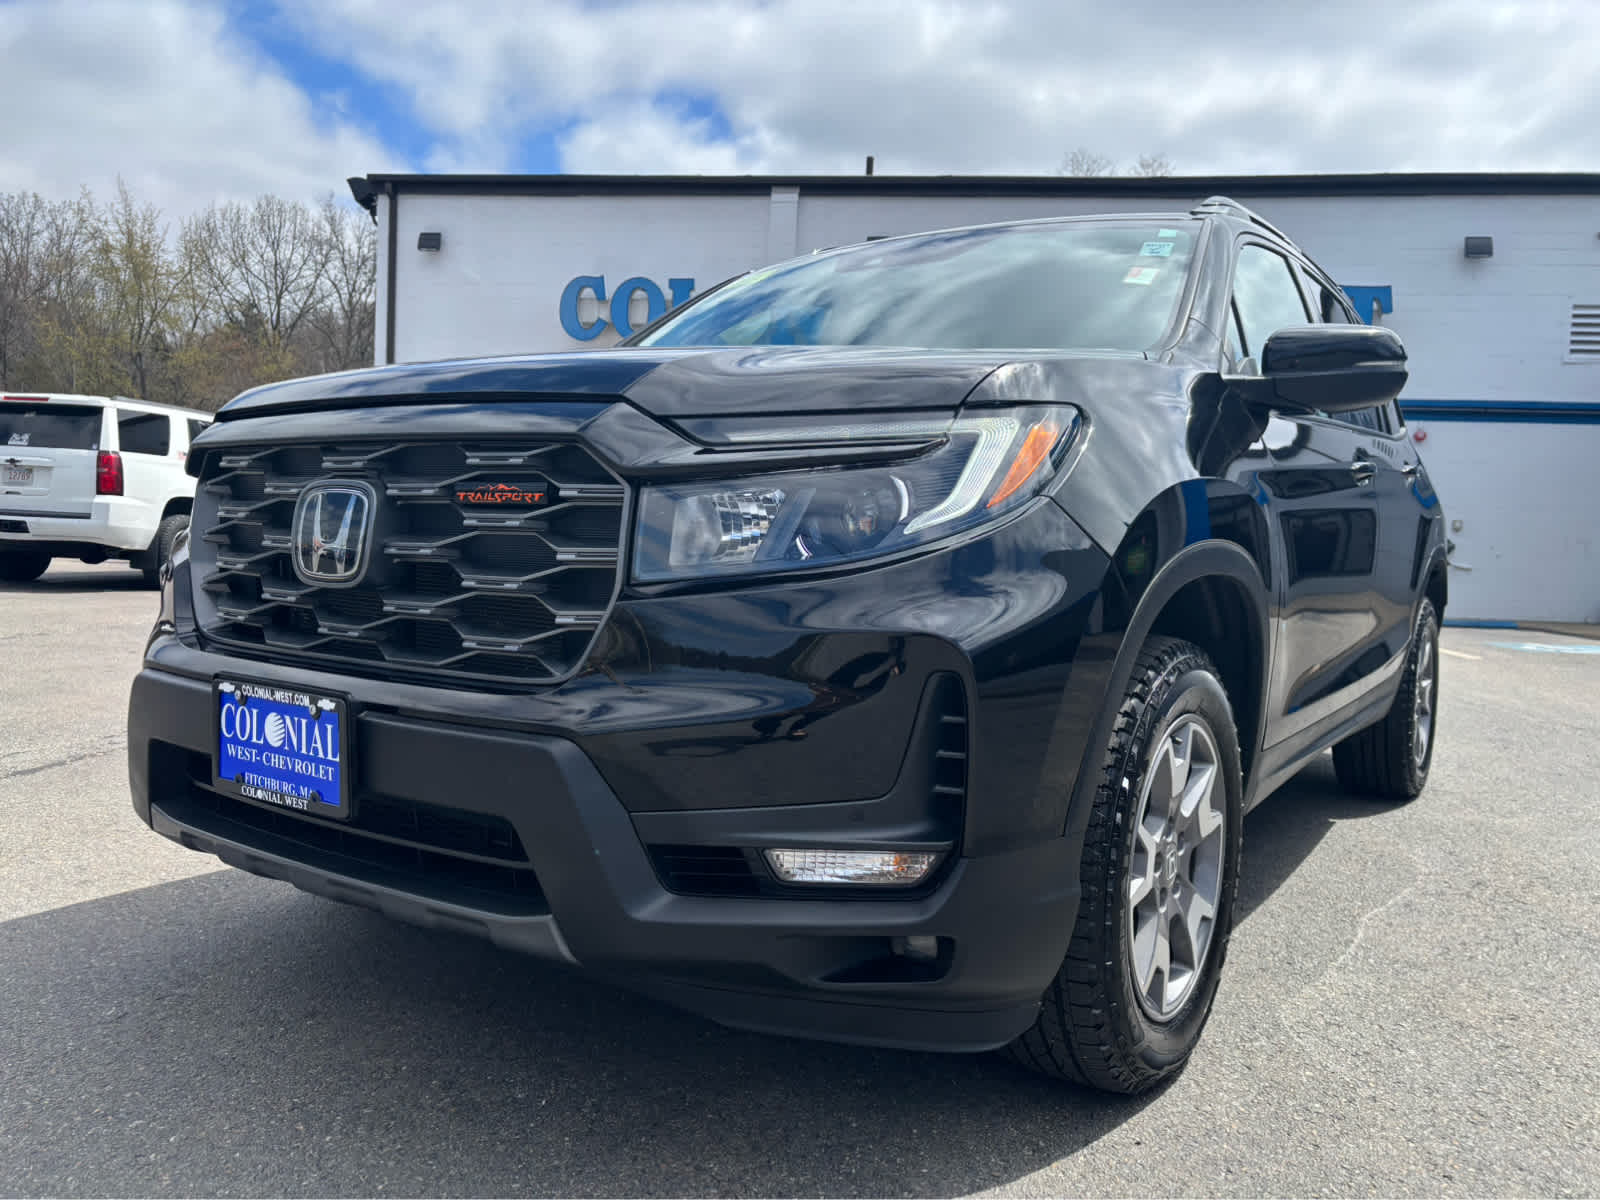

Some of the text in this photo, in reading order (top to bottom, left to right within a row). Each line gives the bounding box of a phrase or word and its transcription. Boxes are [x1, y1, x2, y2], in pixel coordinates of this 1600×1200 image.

[456, 492, 545, 504] TRAILSPORT
[220, 703, 340, 762] COLONIAL
[262, 751, 335, 782] CHEVROLET
[241, 785, 309, 811] COLONIAL WEST
